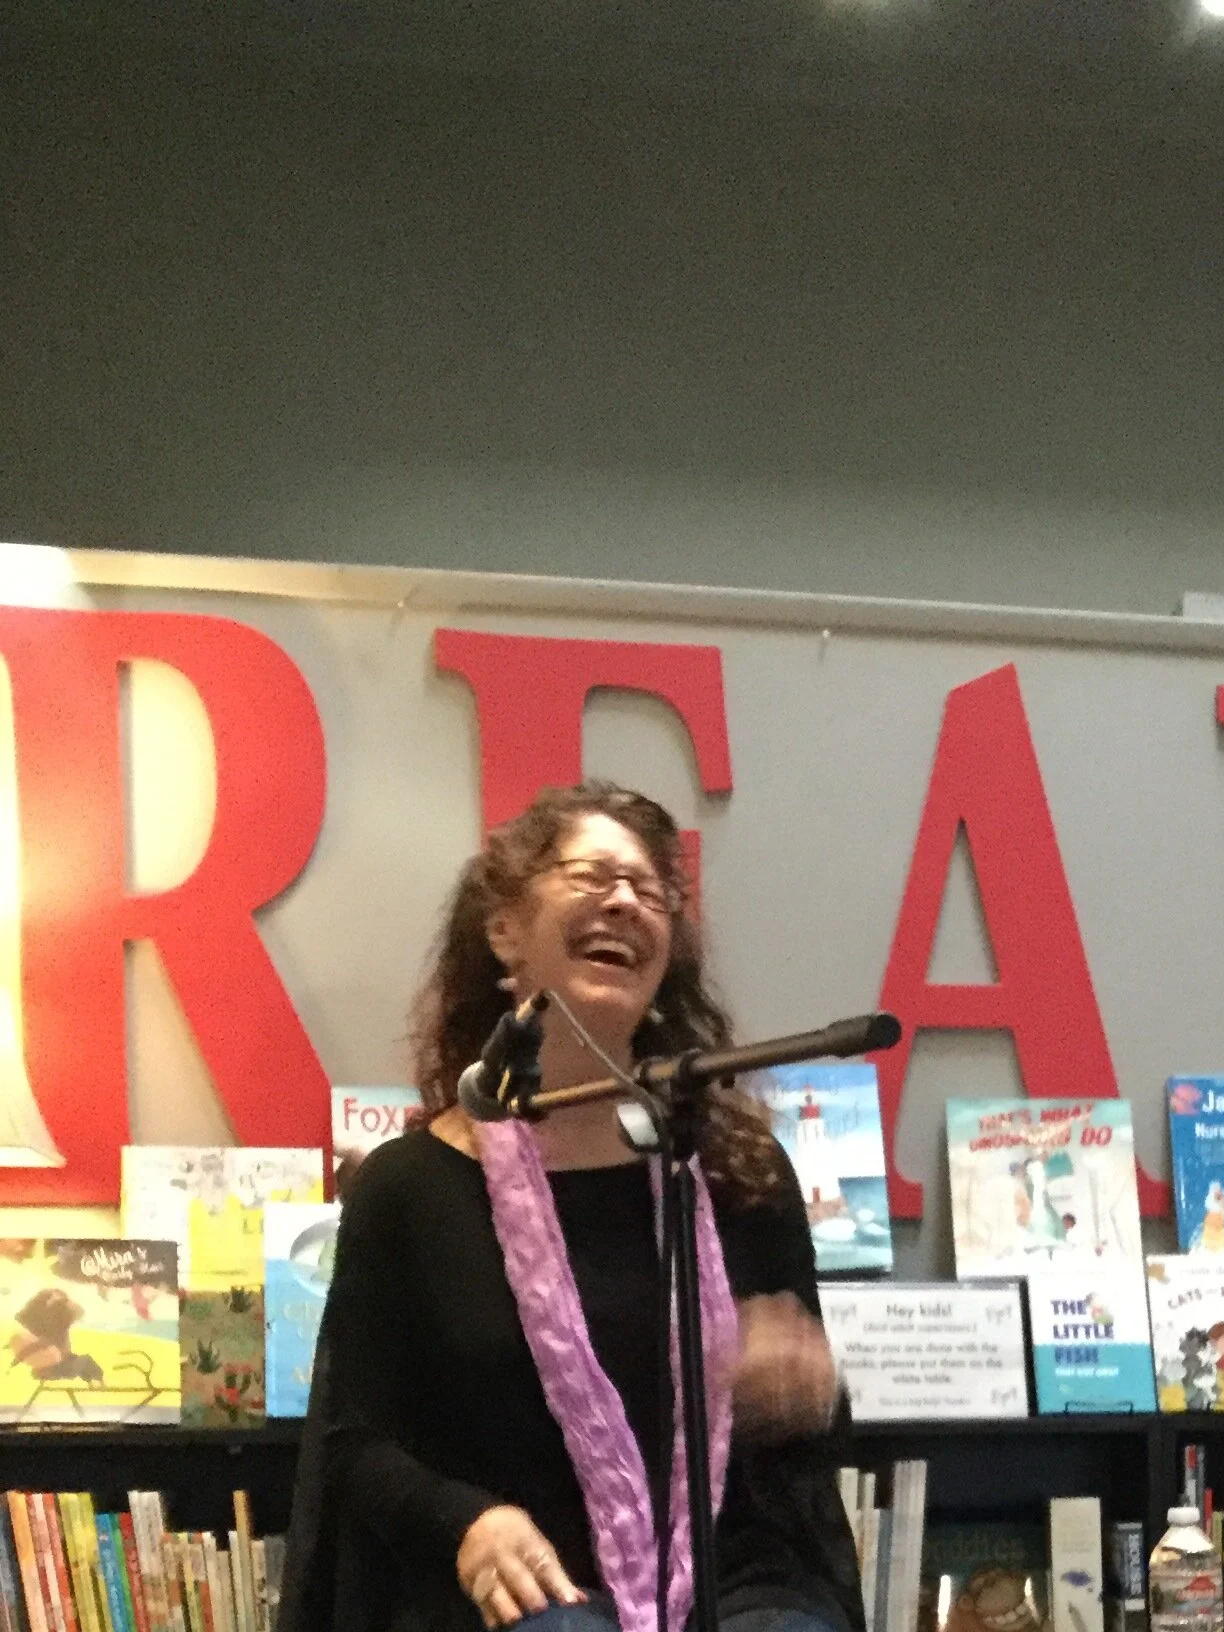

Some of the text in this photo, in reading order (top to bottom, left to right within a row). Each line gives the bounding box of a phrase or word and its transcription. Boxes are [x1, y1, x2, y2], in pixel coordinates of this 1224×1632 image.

[1167, 1288, 1203, 1310] CATS
[886, 1303, 915, 1318] Hey
[1050, 1299, 1088, 1316] THE
[1052, 1323, 1114, 1340] LITTLE
[844, 1342, 877, 1354] When
[981, 1342, 999, 1353] the
[986, 1357, 1003, 1369] the
